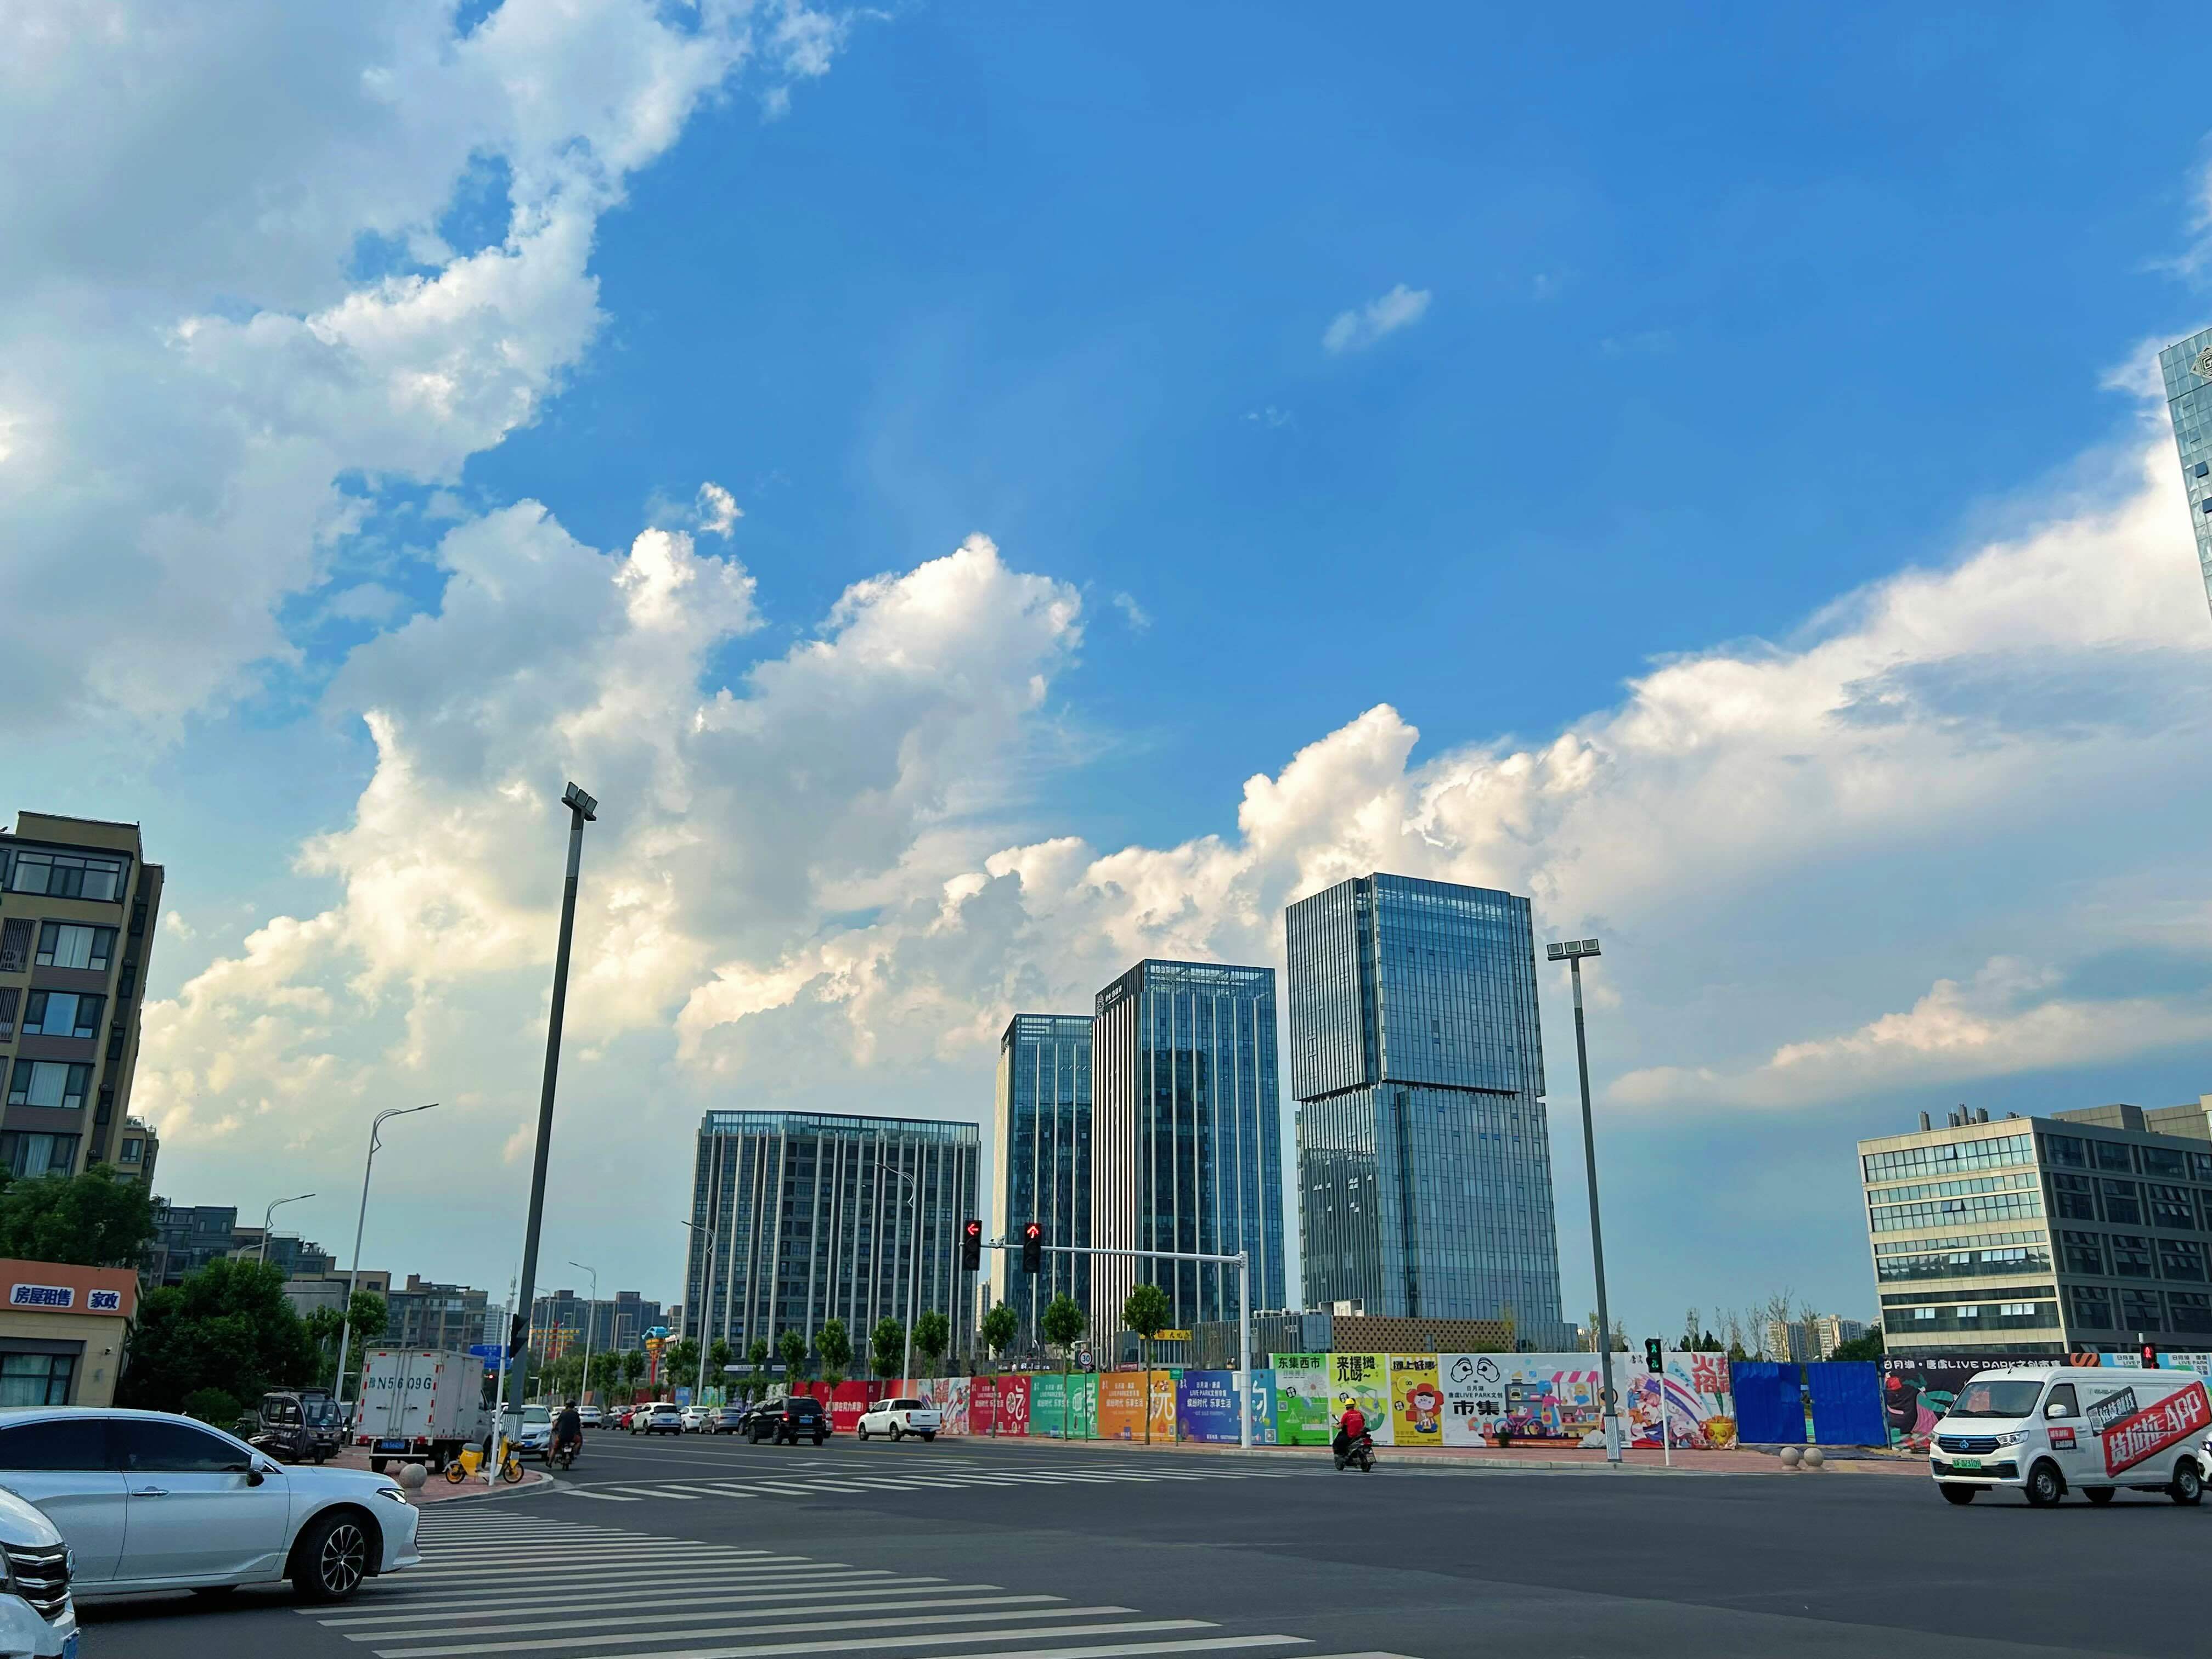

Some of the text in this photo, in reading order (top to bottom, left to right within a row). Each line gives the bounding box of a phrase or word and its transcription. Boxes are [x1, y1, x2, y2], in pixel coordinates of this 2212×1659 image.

[14, 1286, 119, 1309] 房屋租售 家政
[1278, 1357, 1320, 1369] 东集西市
[1336, 1356, 1375, 1369] 来摆摊
[1453, 1400, 1500, 1415] 市集
